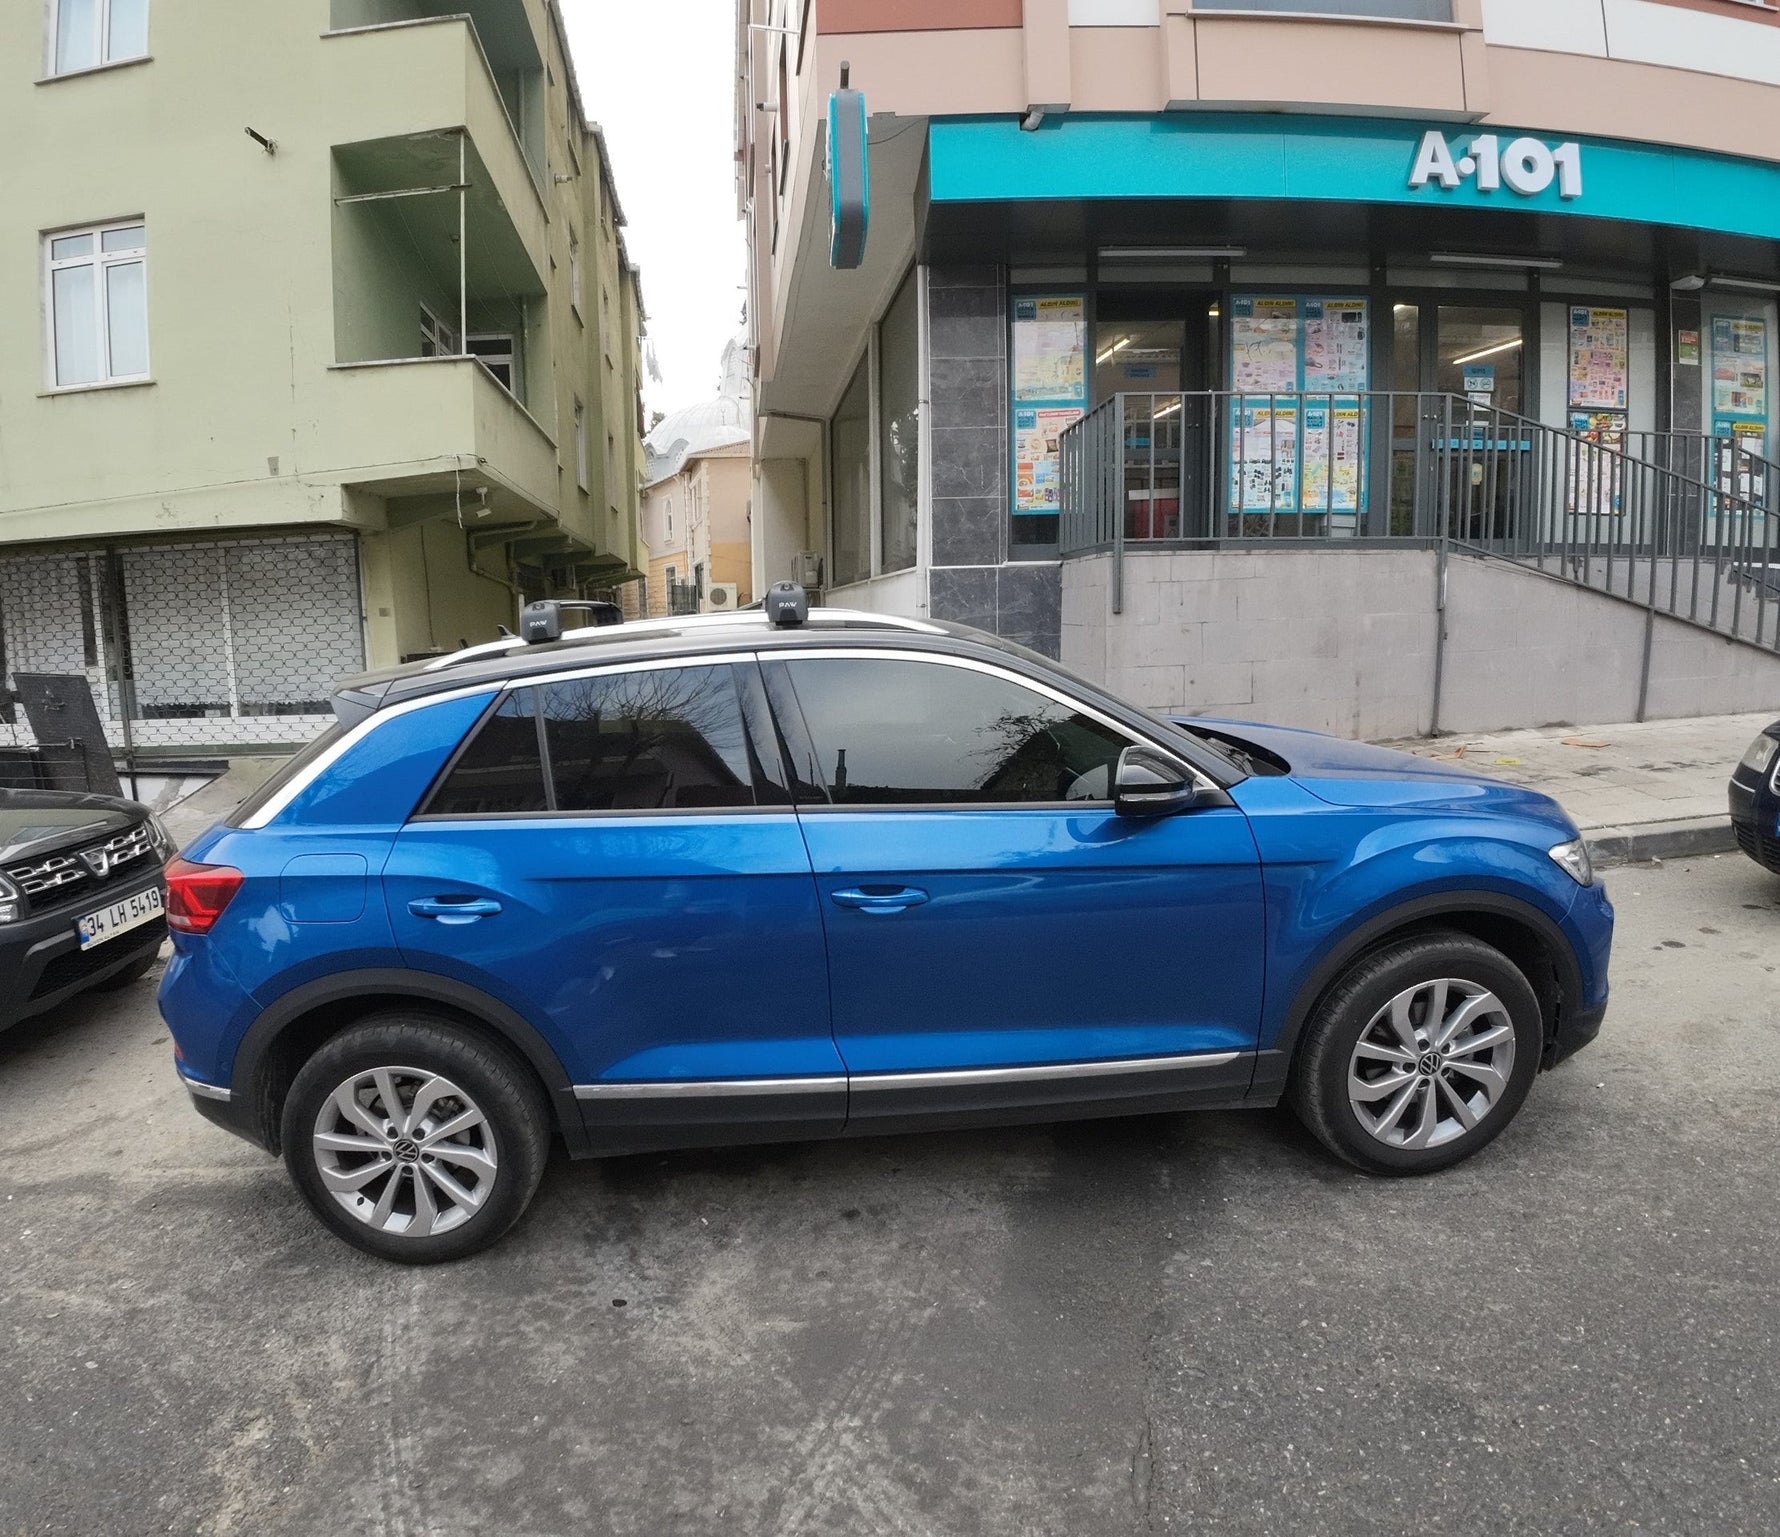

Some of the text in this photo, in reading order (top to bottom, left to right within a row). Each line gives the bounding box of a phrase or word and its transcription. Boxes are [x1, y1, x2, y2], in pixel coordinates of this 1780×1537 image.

[87, 890, 159, 936] 34 LH 5419
